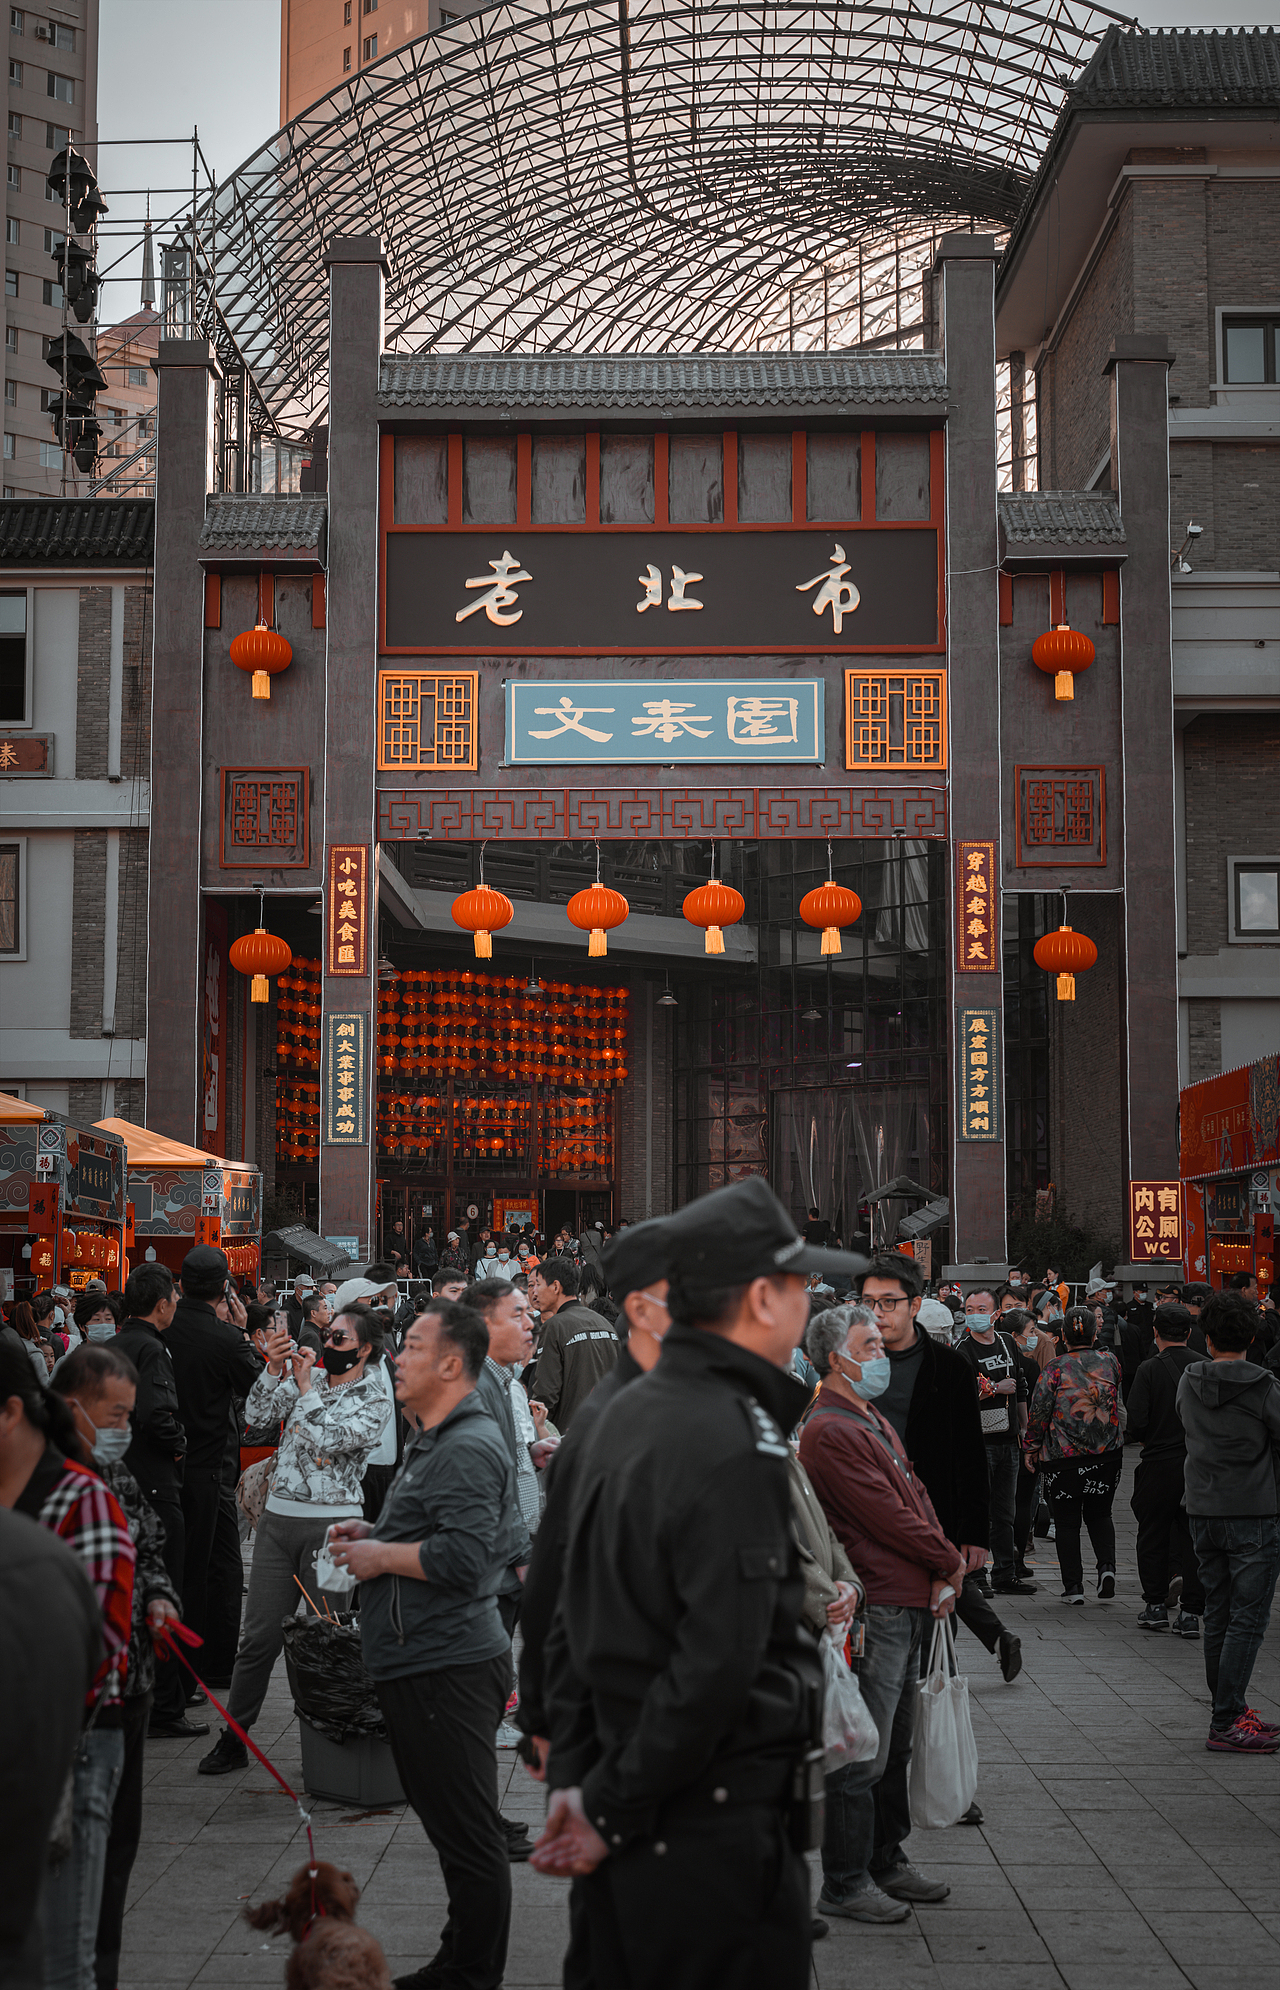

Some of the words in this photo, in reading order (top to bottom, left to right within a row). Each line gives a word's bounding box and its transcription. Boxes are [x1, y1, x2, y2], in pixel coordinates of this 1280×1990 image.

[455, 544, 862, 634] 老北市
[528, 696, 798, 745] 文奉園
[336, 857, 359, 964] 小吃美食匯
[965, 851, 989, 960] 穿越老奉天
[39, 1156, 50, 1170] 福
[33, 1199, 45, 1215] 福
[1135, 1186, 1178, 1212] 内有
[470, 1207, 476, 1217] 6
[1135, 1215, 1179, 1238] 公厕
[1143, 1241, 1170, 1254] WC
